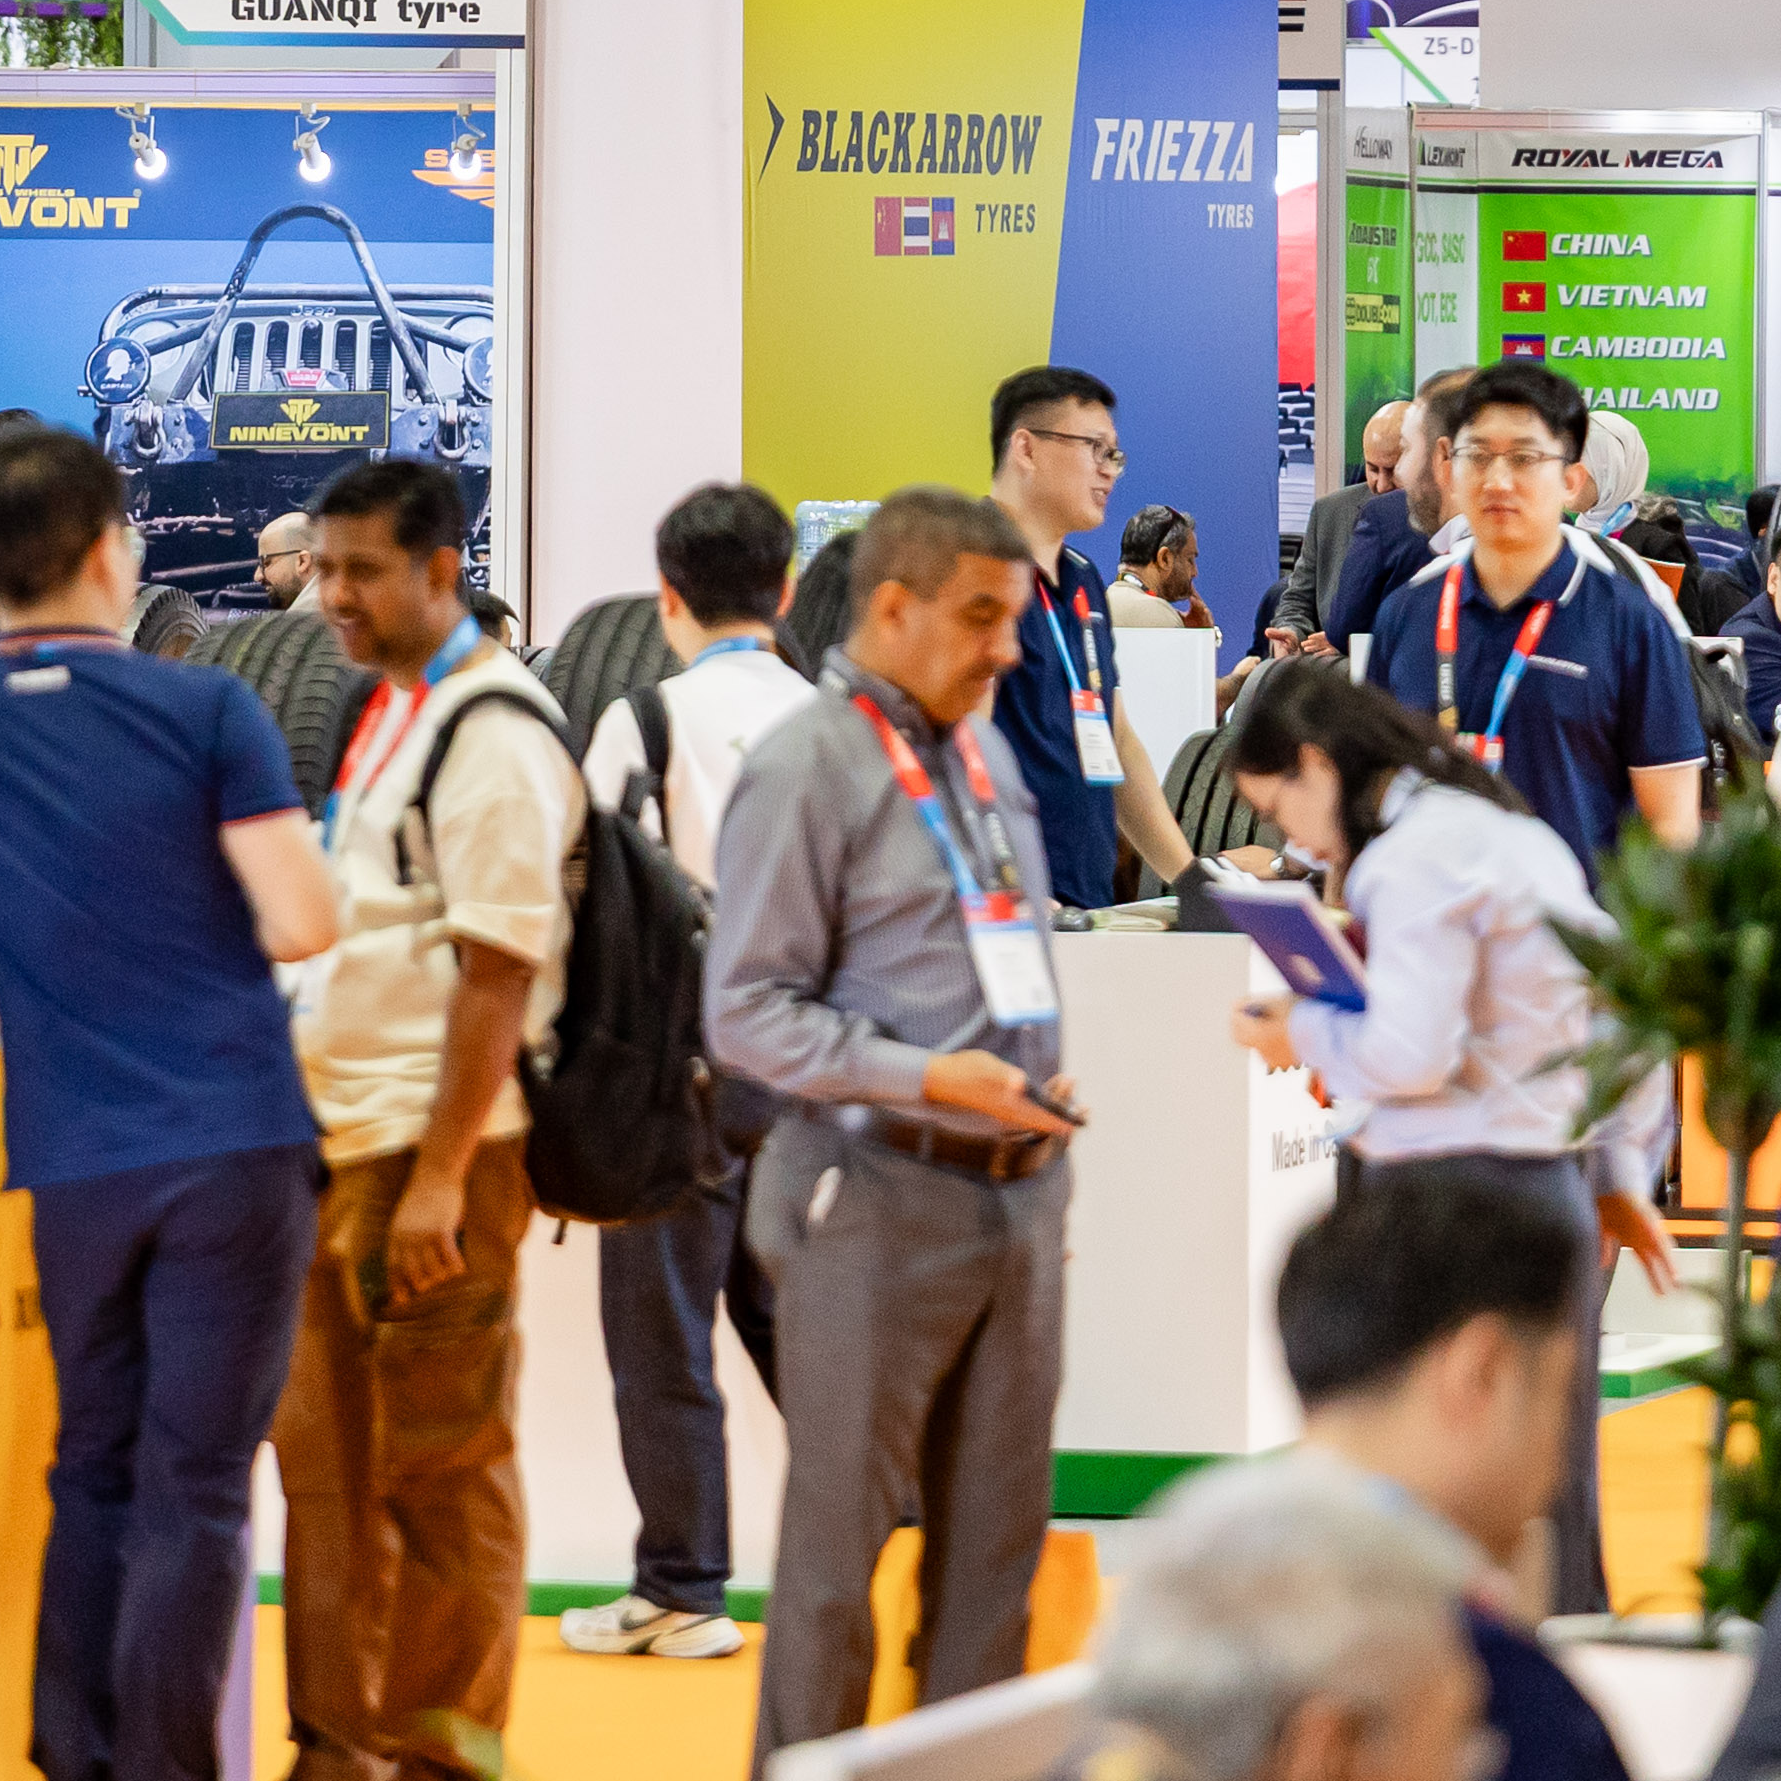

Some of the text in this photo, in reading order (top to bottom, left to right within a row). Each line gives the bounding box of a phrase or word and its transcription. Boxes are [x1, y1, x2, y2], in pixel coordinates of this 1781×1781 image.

[1424, 37, 1474, 55] Z5-D
[796, 109, 1043, 176] BLACKARROW
[1091, 117, 1254, 183] FRIEZZA
[1511, 148, 1724, 169] ROYAL MEGA
[974, 203, 1036, 234] TYRES
[1207, 203, 1254, 229] TYRES
[1551, 233, 1652, 256] CHINA
[1557, 284, 1708, 308] VIETNAM
[1550, 335, 1727, 359] CAMBODIA
[230, 424, 369, 442] NINEVONT
